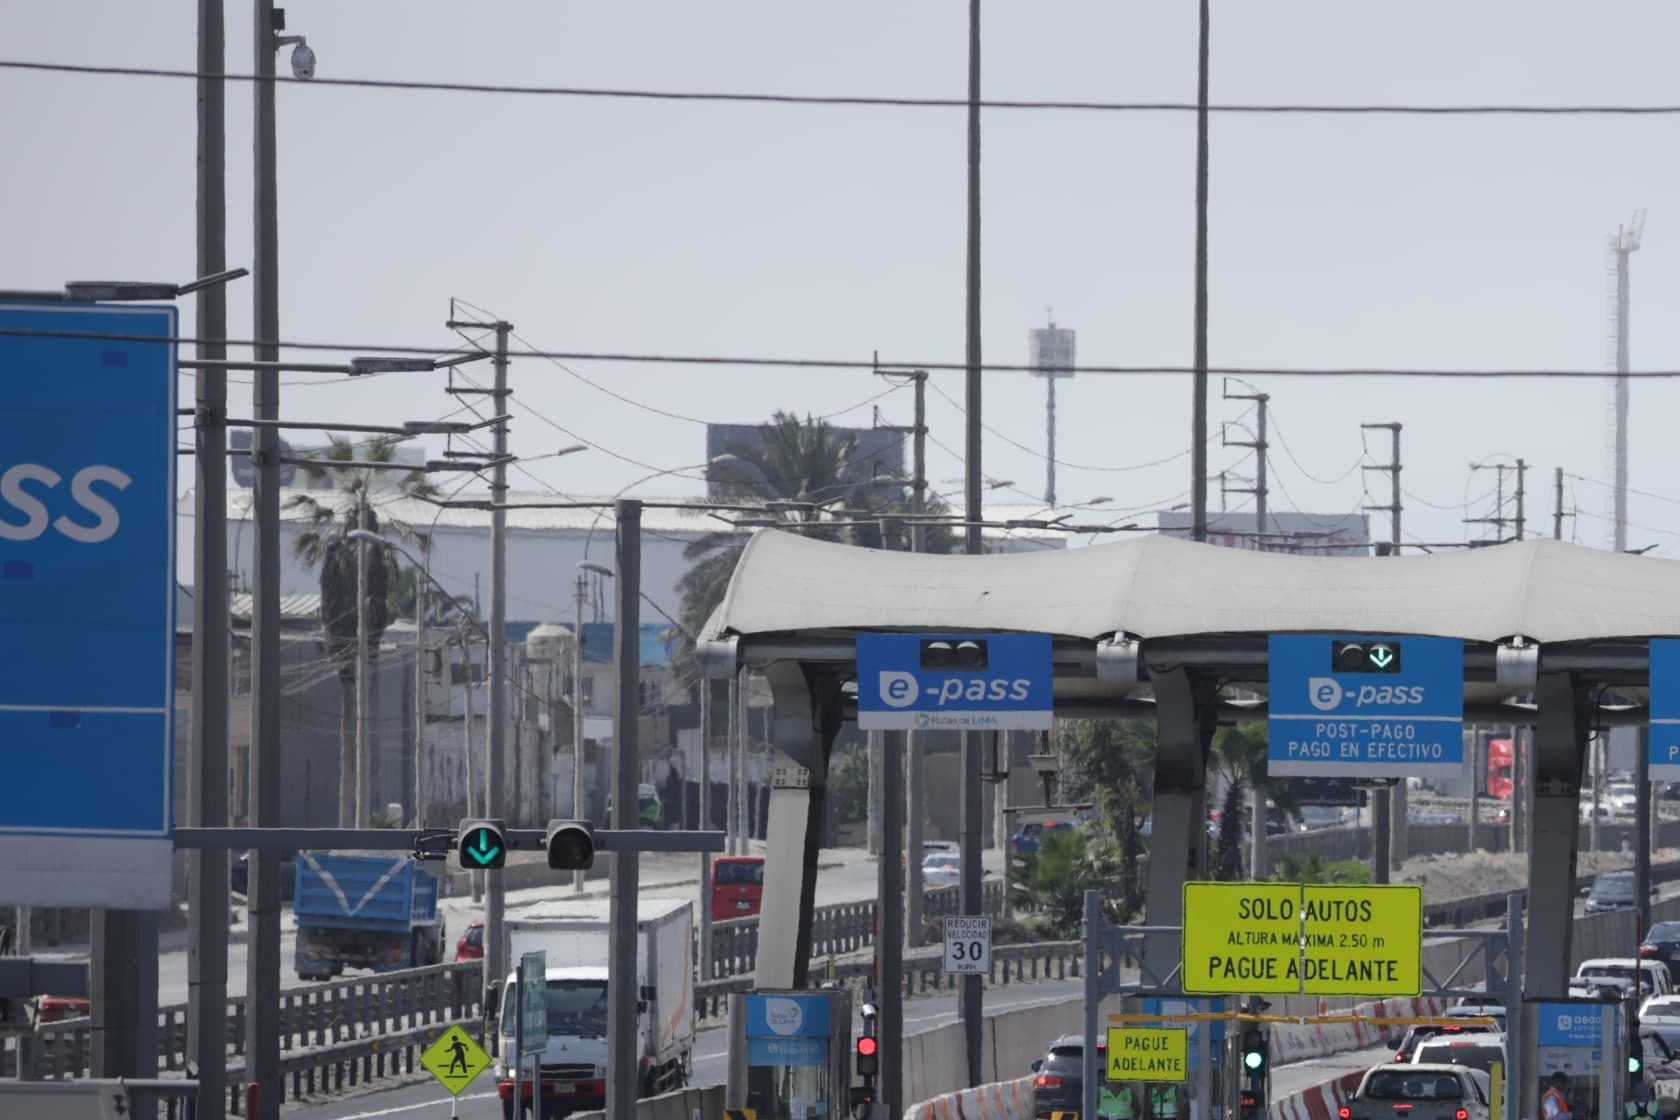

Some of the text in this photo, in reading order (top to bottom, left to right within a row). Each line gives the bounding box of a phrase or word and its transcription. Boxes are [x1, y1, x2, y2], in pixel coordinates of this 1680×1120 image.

[972, 714, 998, 726] LIMA
[1316, 723, 1416, 740] POST-PAGO
[1288, 741, 1443, 759] PAGO EN EFECTIVO
[1238, 898, 1372, 922] SOLO AUTOS
[947, 919, 987, 929] REDUCIR
[1227, 931, 1278, 945] ALTURA
[1339, 933, 1368, 948] 2.50
[1373, 935, 1385, 948] m
[952, 941, 982, 961] 30
[1208, 956, 1399, 981] PAGUE ADELANTE
[1124, 1036, 1169, 1051] PAGUE
[1111, 1057, 1182, 1072] ADELANTE
